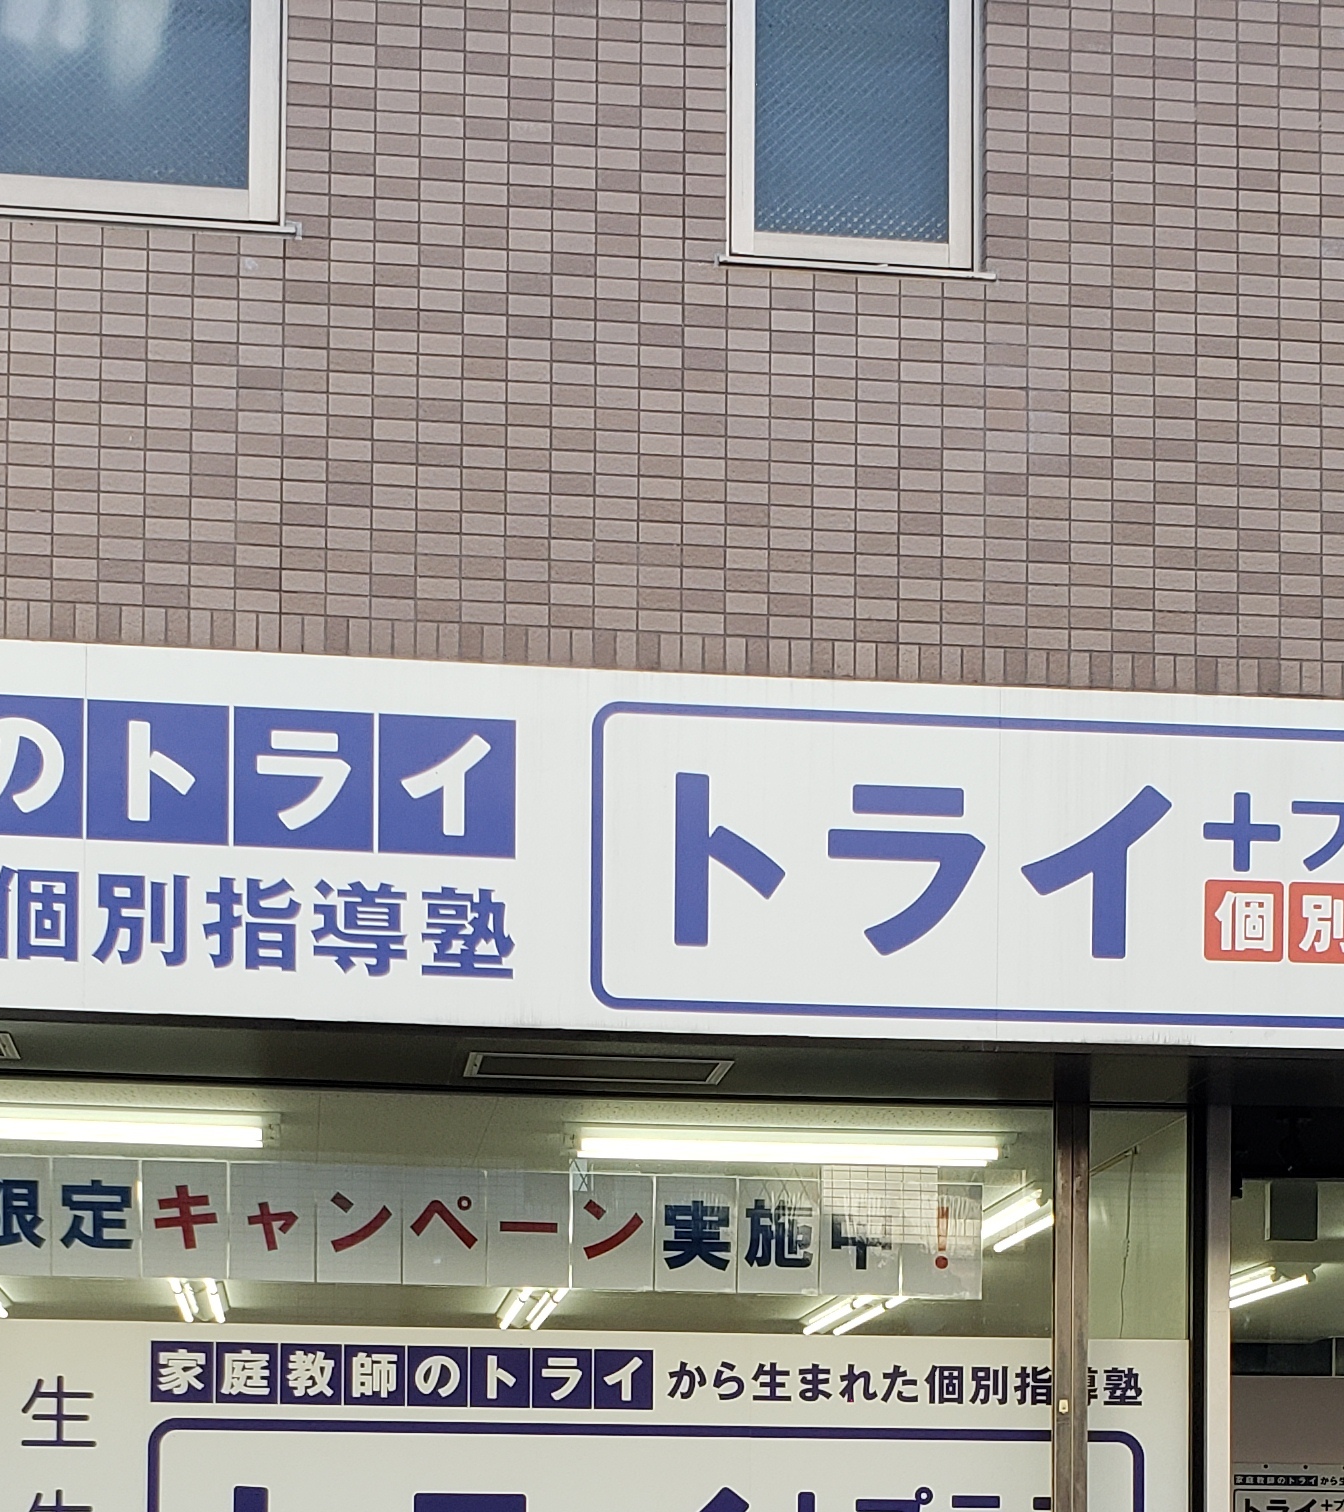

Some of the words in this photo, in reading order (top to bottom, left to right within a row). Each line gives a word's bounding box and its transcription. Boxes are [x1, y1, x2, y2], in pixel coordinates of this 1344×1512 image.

[157, 1350, 646, 1402] 家庭教師のトライ
[667, 1361, 1143, 1407] から生まれた個別指塾
